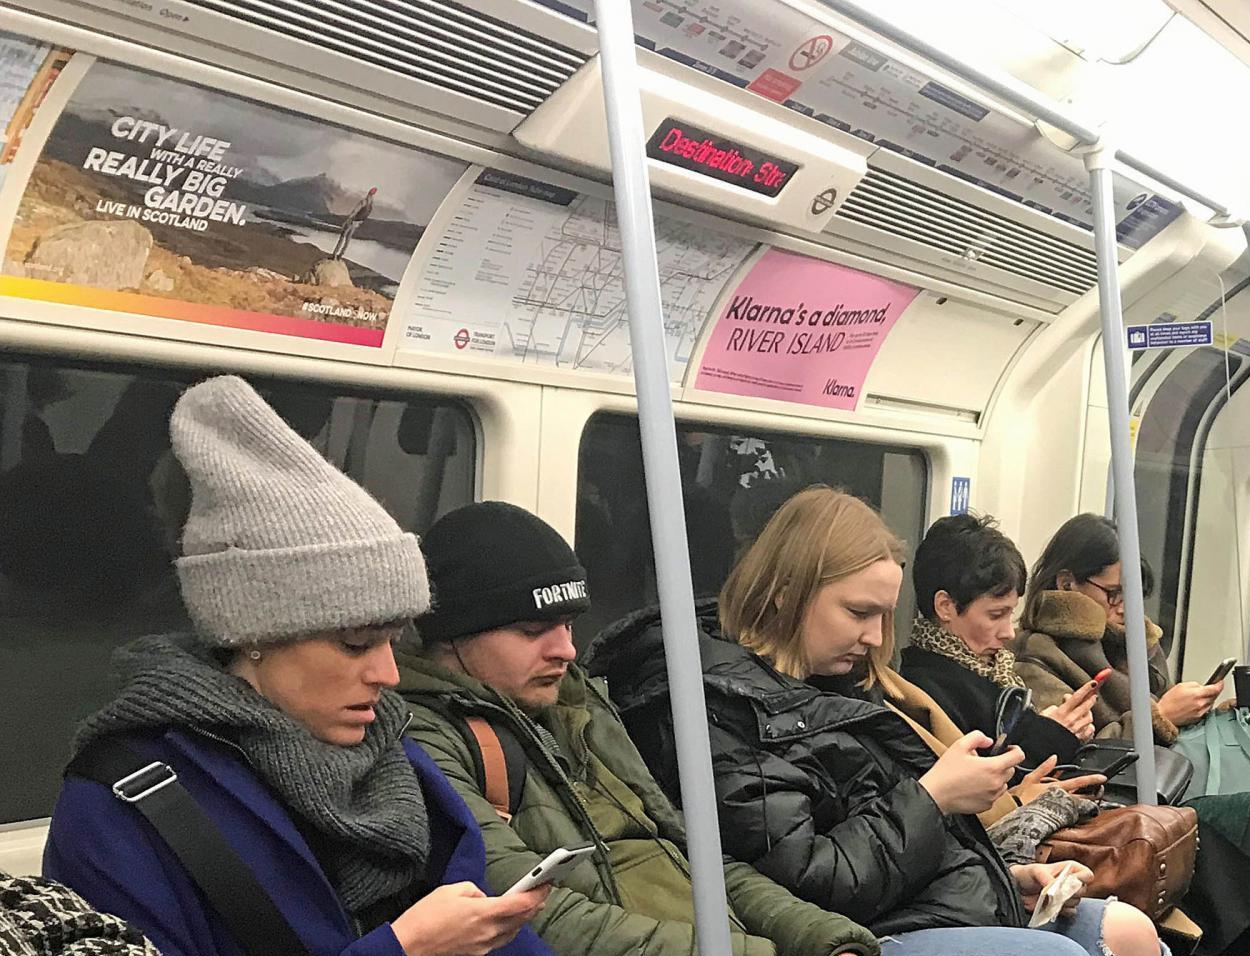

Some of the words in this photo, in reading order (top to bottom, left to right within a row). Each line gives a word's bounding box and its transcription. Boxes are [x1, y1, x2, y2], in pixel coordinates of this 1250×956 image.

[111, 116, 177, 147] CITY
[174, 132, 231, 162] LIFE
[83, 147, 184, 187] REALLY
[182, 170, 227, 198] BIG
[150, 147, 183, 166] WITH
[183, 157, 194, 168] A
[197, 159, 243, 179] REALLY
[96, 199, 125, 217] LIVE
[126, 204, 141, 219] IN
[141, 209, 208, 232] SCOTLAND
[144, 186, 247, 226] GARDEN.
[725, 296, 807, 326] Klarna's
[808, 309, 823, 326] a
[822, 302, 891, 327] diamond,
[726, 328, 785, 354] RIVER
[786, 332, 846, 355] ISLAND
[532, 580, 587, 609] FORTNITE
